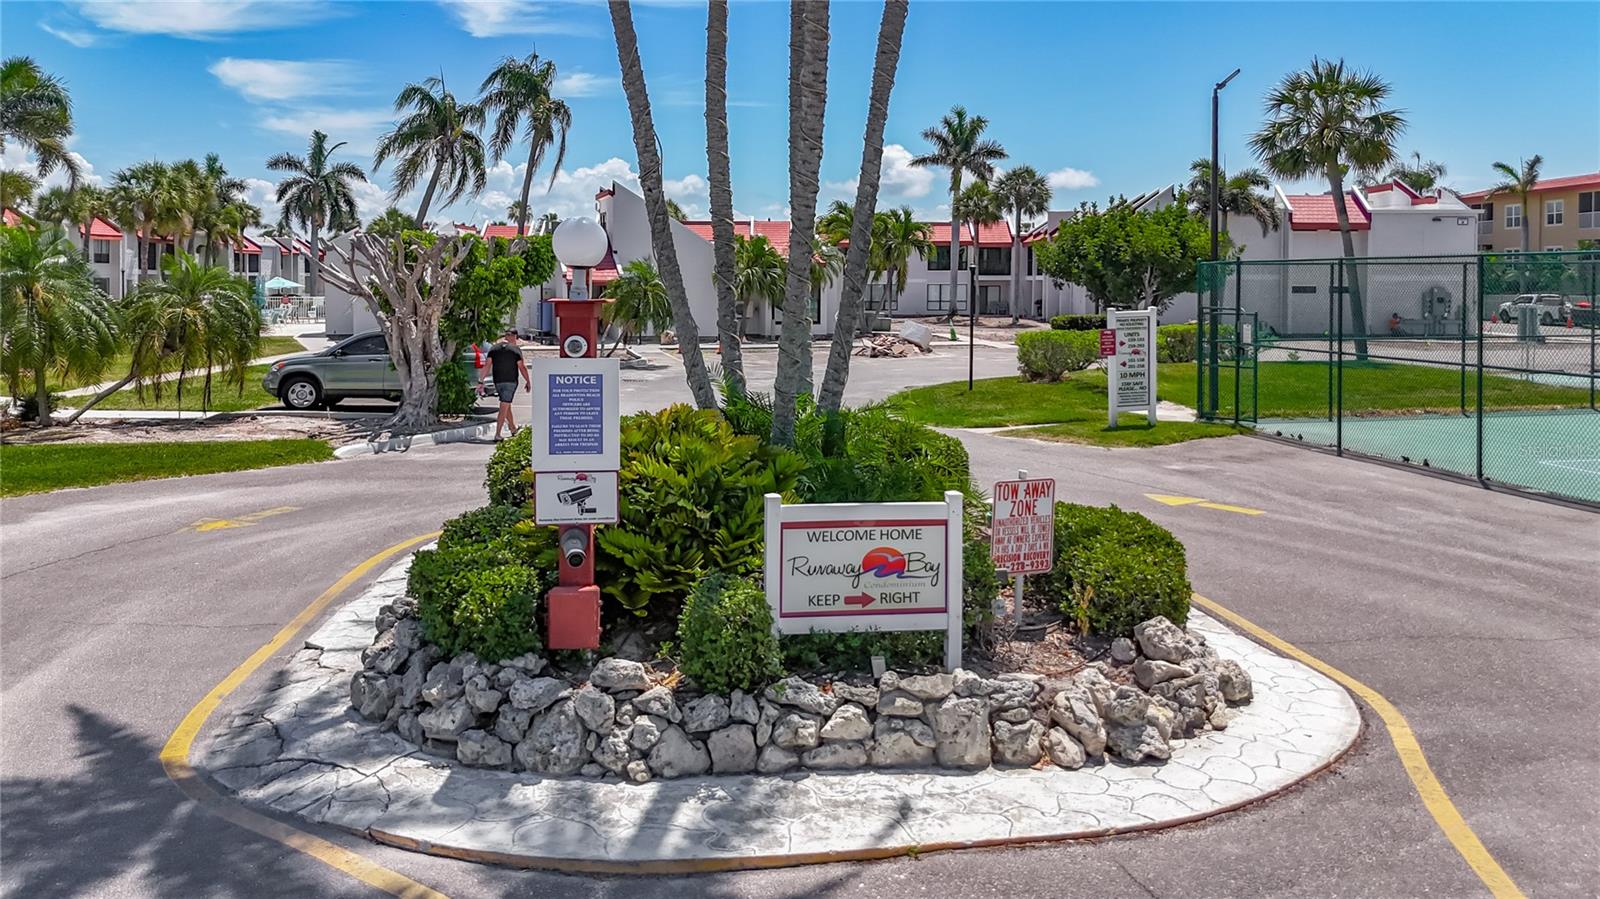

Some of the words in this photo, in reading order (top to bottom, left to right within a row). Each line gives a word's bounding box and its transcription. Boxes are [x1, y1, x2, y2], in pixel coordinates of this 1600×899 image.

[556, 376, 597, 384] NOTICE
[998, 484, 1019, 501] TOW
[1024, 482, 1052, 499] AWAY
[1010, 499, 1037, 517] ZONE
[1030, 515, 1050, 523] VEHICLES
[807, 529, 876, 543] WELCOME
[880, 529, 922, 540] HOME
[1002, 526, 1019, 535] VESSELS
[1021, 525, 1029, 534] WILL
[1031, 525, 1036, 533] BE
[995, 537, 1005, 545] AWAY
[1006, 536, 1011, 544] AT
[1013, 535, 1030, 543] OWNERS
[1032, 533, 1050, 542] EXPENSE
[1011, 544, 1014, 552] A
[1024, 543, 1026, 551] 7
[1039, 542, 1042, 550] A
[1024, 551, 1049, 560] RECOVERY
[787, 556, 862, 589] Runaway
[902, 552, 941, 587] Bay
[808, 594, 840, 606] KEEP
[880, 592, 920, 604] RIGHT
